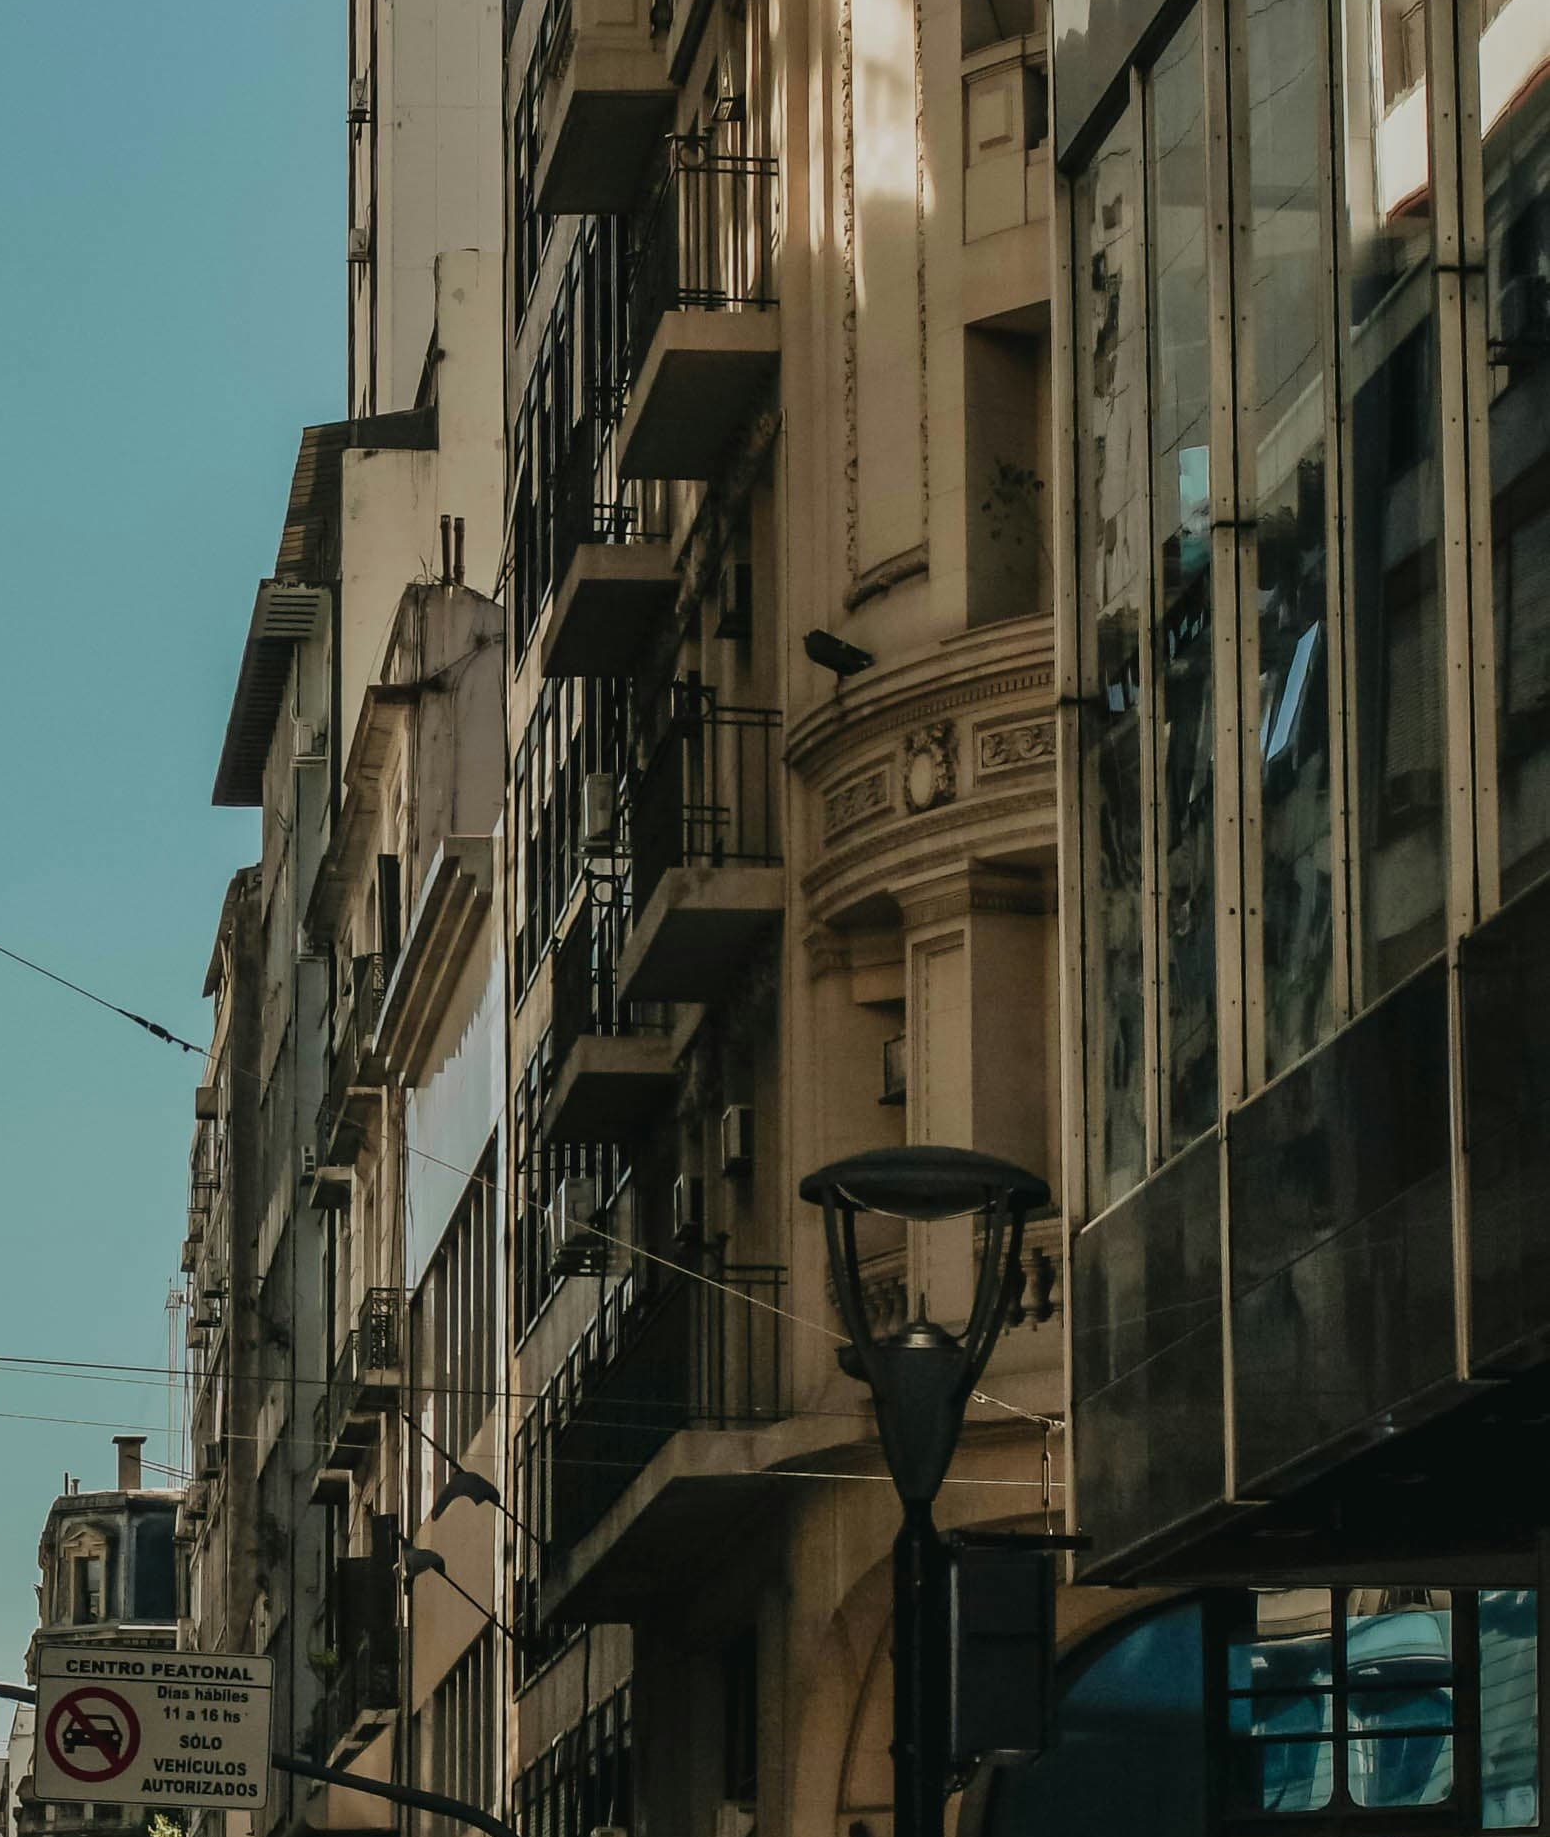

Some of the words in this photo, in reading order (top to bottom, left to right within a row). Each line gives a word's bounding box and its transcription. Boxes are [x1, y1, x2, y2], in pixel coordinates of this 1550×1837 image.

[66, 1659, 145, 1676] CENTRO
[151, 1663, 253, 1682] PEATONAL
[194, 1687, 249, 1703] hábiles
[163, 1706, 177, 1720] 11
[185, 1711, 195, 1720] a
[201, 1707, 219, 1722] 16
[223, 1709, 241, 1724] hs
[179, 1733, 222, 1750] SÓLO
[154, 1757, 248, 1776] VEHÍCULOS
[141, 1779, 258, 1797] AUTORIZADOS
